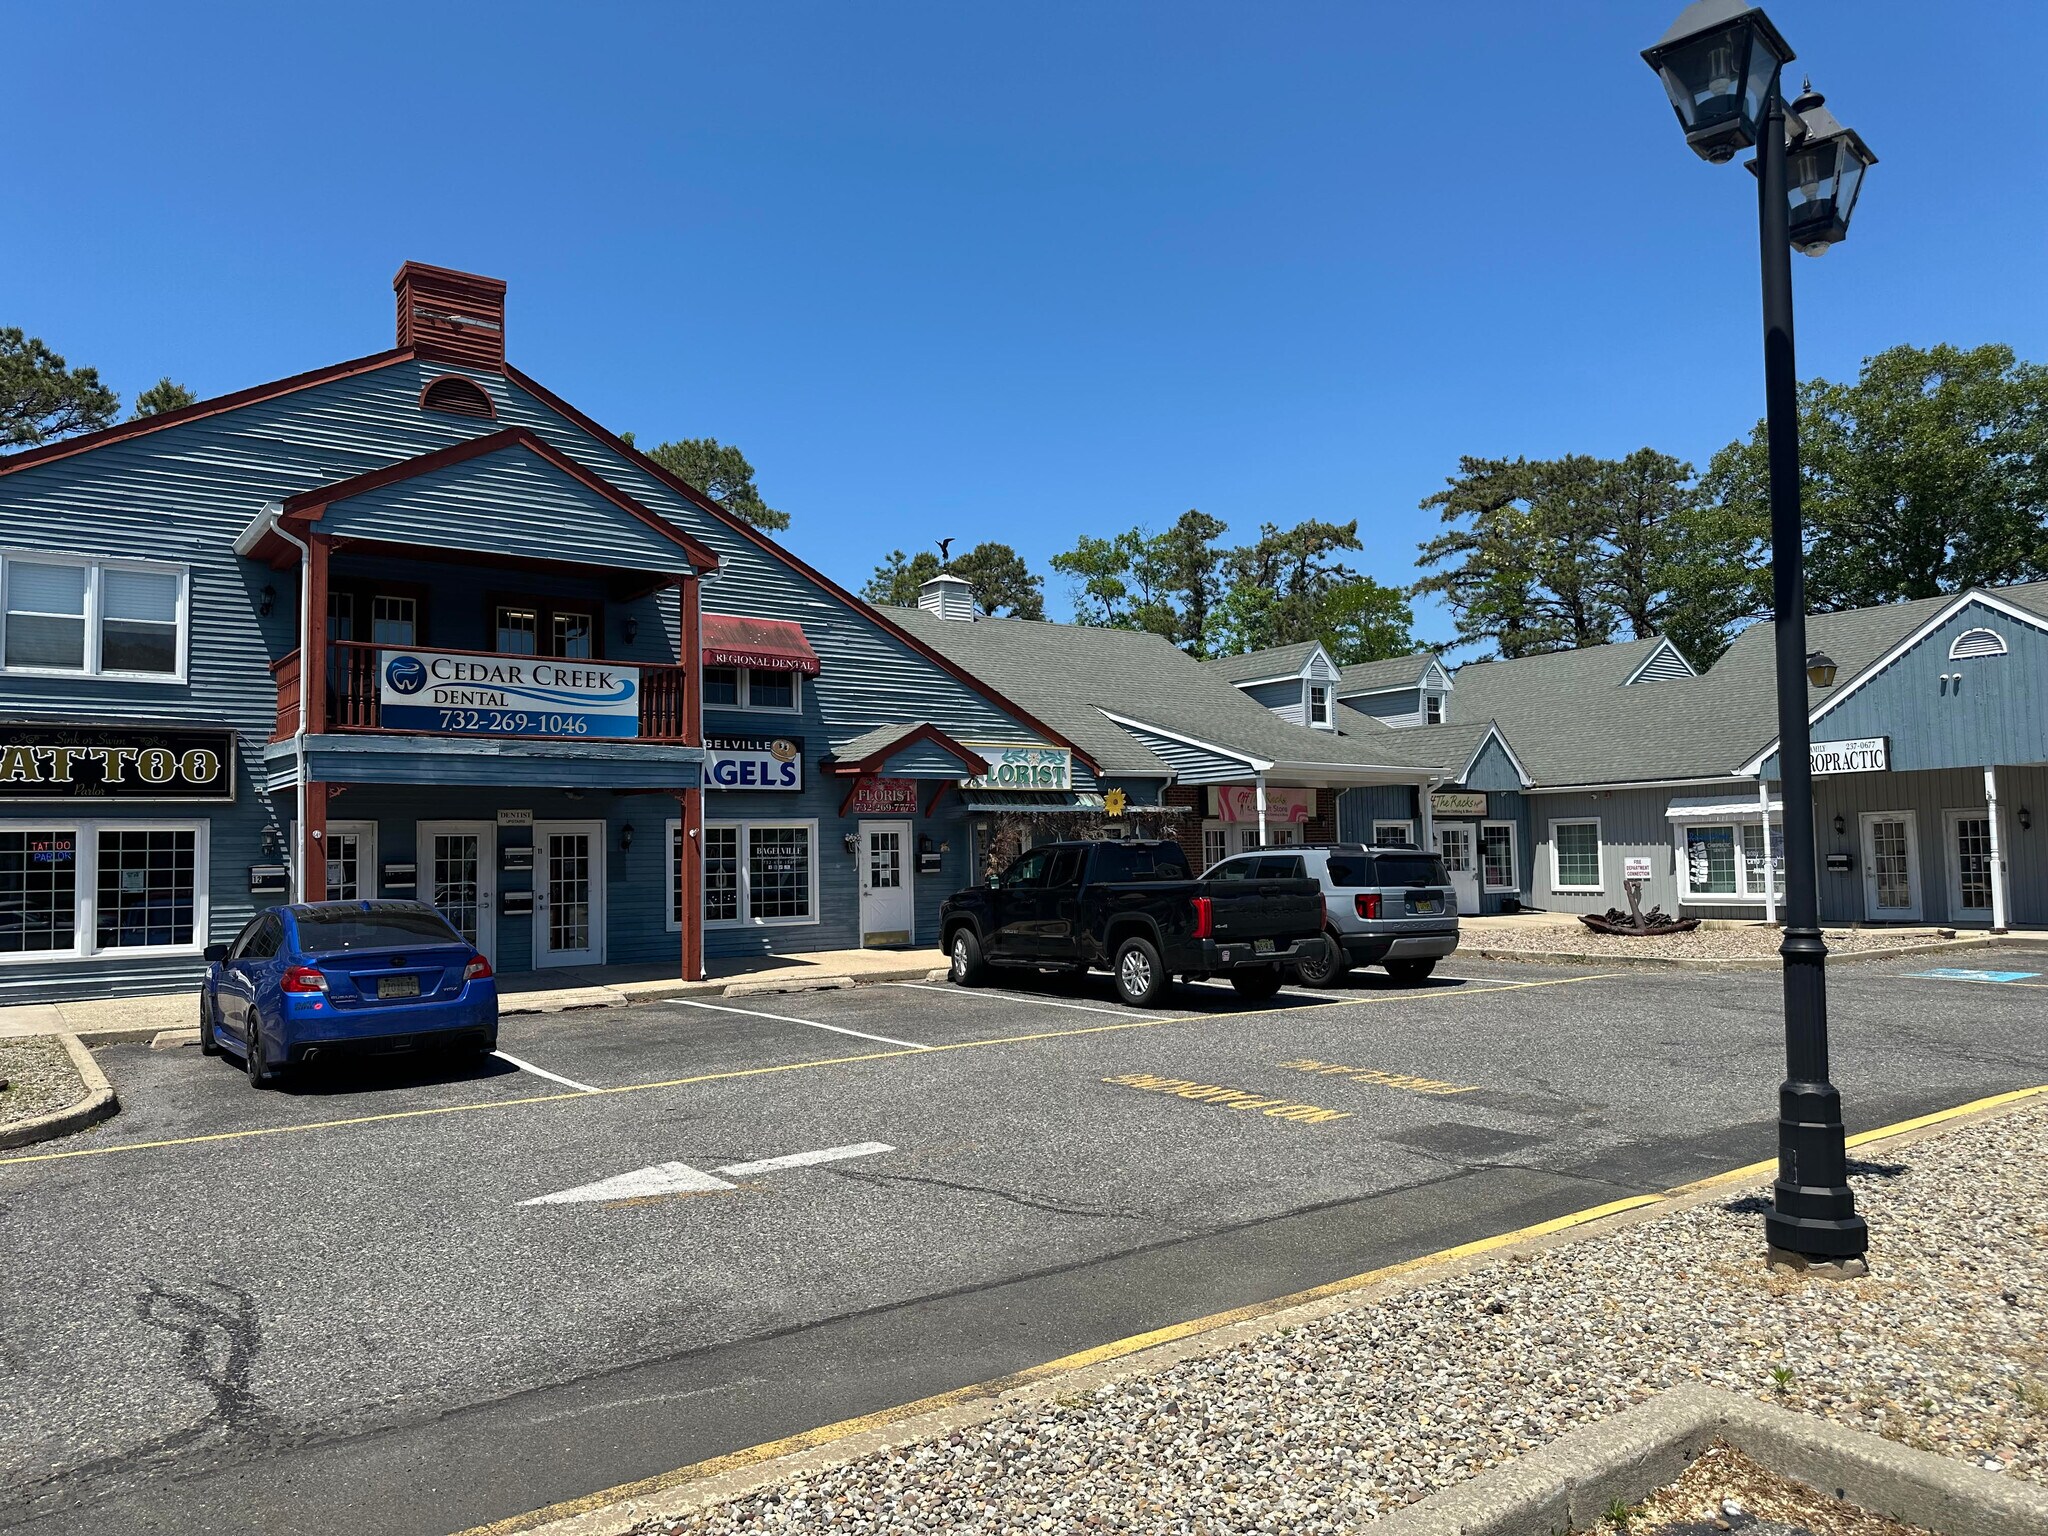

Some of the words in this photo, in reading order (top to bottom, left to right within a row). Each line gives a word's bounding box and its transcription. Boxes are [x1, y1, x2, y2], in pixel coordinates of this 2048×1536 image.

[716, 653, 770, 667] REGIONAL
[772, 657, 814, 671] DENTAL
[431, 658, 524, 684] CEDAR
[532, 665, 618, 689] CREEK
[433, 689, 509, 707] DENTAL
[439, 709, 588, 734] 732-269-1046
[54, 731, 80, 744] Sink
[96, 733, 126, 745] Swim
[1846, 741, 1876, 750] 237-0677
[0, 746, 221, 783] ATTOO
[1810, 749, 1884, 773] ROPRACTIC
[986, 763, 1066, 785] LORIST
[74, 783, 106, 796] Parlor
[858, 789, 913, 801] FLORIST
[1436, 795, 1450, 808] The
[1450, 794, 1474, 808] Racks
[500, 811, 531, 819] DENTIST
[31, 841, 71, 851] TATTOO
